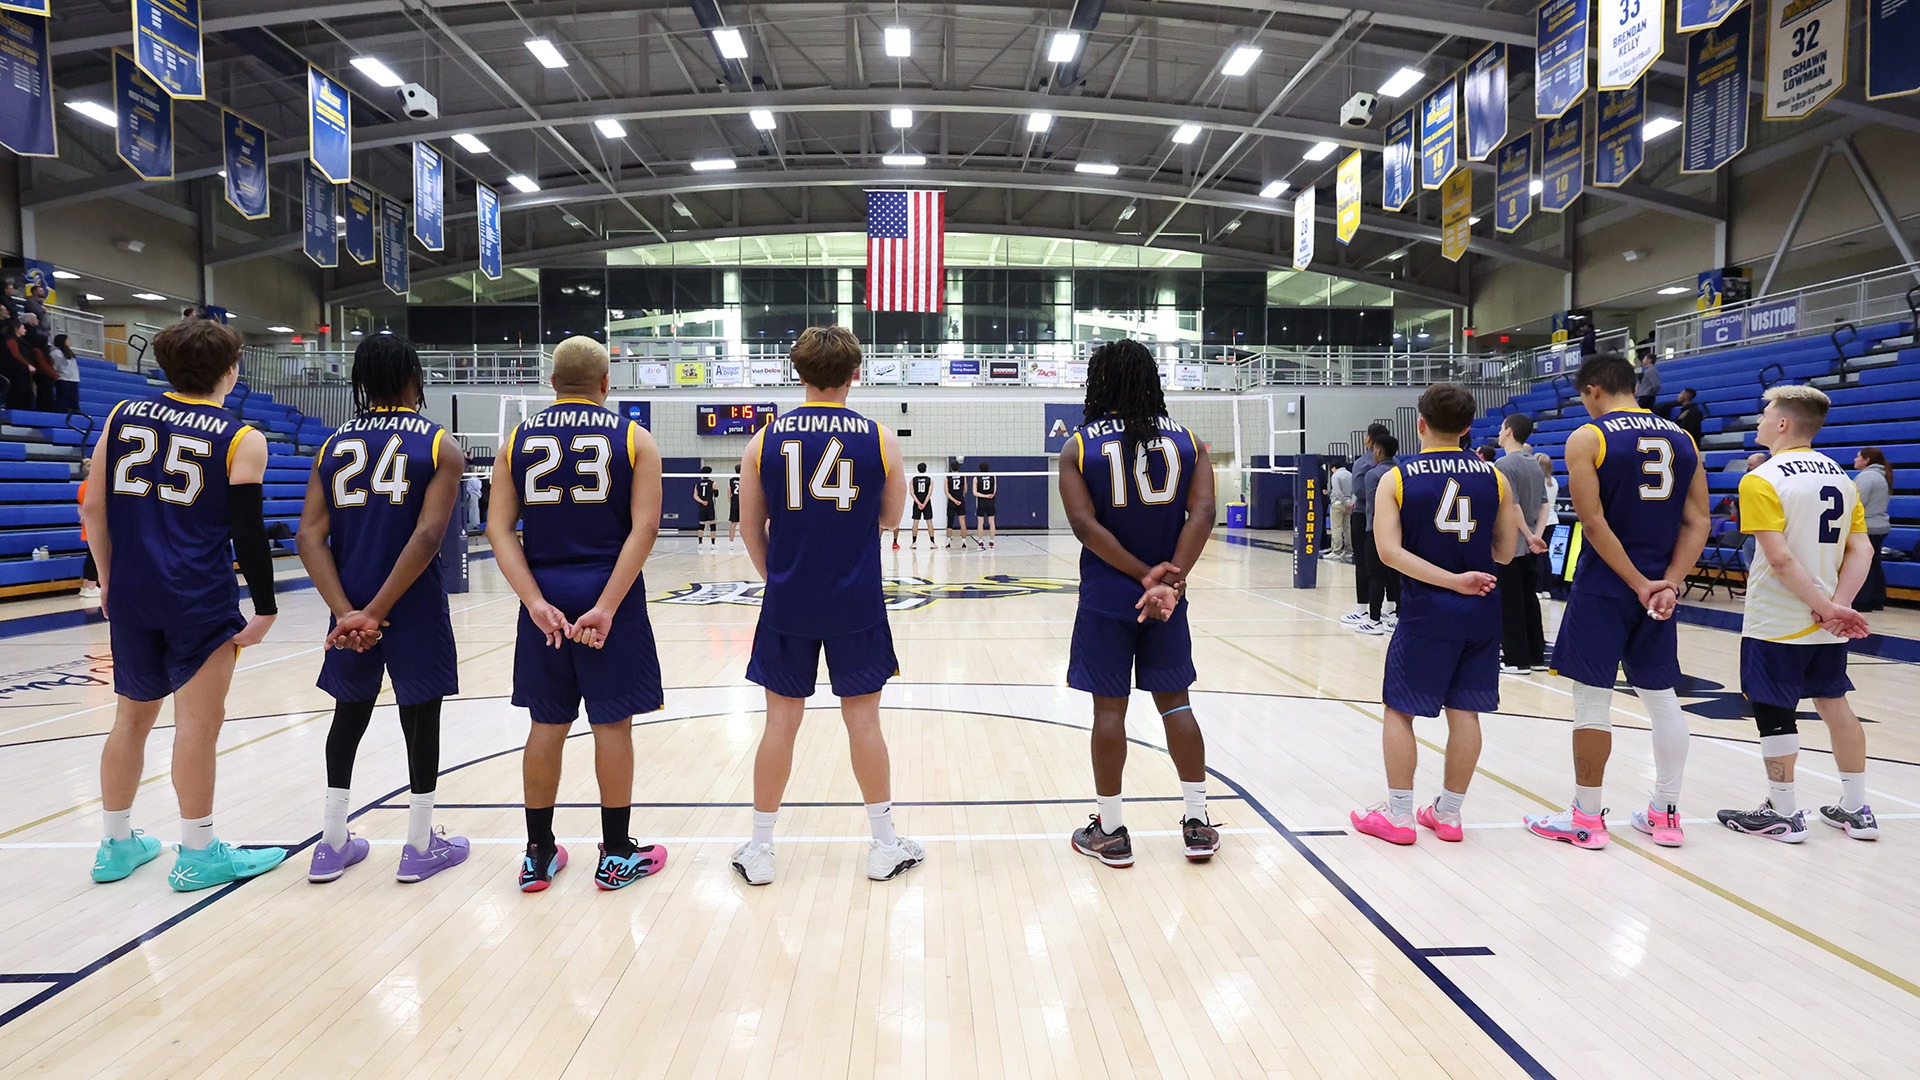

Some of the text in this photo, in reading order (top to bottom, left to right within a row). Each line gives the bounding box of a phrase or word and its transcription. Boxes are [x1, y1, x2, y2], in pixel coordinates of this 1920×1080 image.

[1619, 0, 1641, 25] 33
[1613, 18, 1647, 49] BRENDAN
[1791, 19, 1820, 57] 32
[1619, 35, 1641, 57] KELLY
[1783, 49, 1827, 80] DESHAWN
[1784, 63, 1825, 92] LOWMAN
[1777, 78, 1832, 109] Men's Basketball
[1432, 149, 1444, 171] 18
[1615, 145, 1624, 166] 5
[1556, 173, 1569, 194] 10
[1509, 198, 1516, 215] 8
[1703, 314, 1742, 329] SECTION
[1751, 306, 1796, 332] VISITOR
[1715, 327, 1728, 342] C
[1544, 361, 1553, 373] B
[123, 401, 228, 434] NEUMANN
[523, 410, 619, 431] NEUMANN
[707, 413, 717, 427] 0
[731, 405, 753, 418] 1:15
[756, 405, 773, 413] Guests
[335, 417, 432, 437] NEUMANN
[728, 426, 744, 434] period
[773, 416, 871, 434] NEUMANN
[1087, 416, 1183, 439] NEUNN
[113, 424, 211, 506] 25
[332, 434, 410, 508] 24
[521, 434, 612, 505] 23
[781, 436, 860, 512] 14
[1102, 437, 1182, 508] 10
[1406, 459, 1491, 476] NEUMANN
[1637, 437, 1675, 500] 3
[702, 486, 706, 496] 1
[733, 484, 739, 494] 2
[918, 482, 925, 493] 10
[953, 479, 960, 490] 12
[983, 480, 990, 490] 13
[1305, 479, 1315, 555] KNIGHTS
[1434, 477, 1477, 543] 4
[1818, 486, 1844, 544] 2
